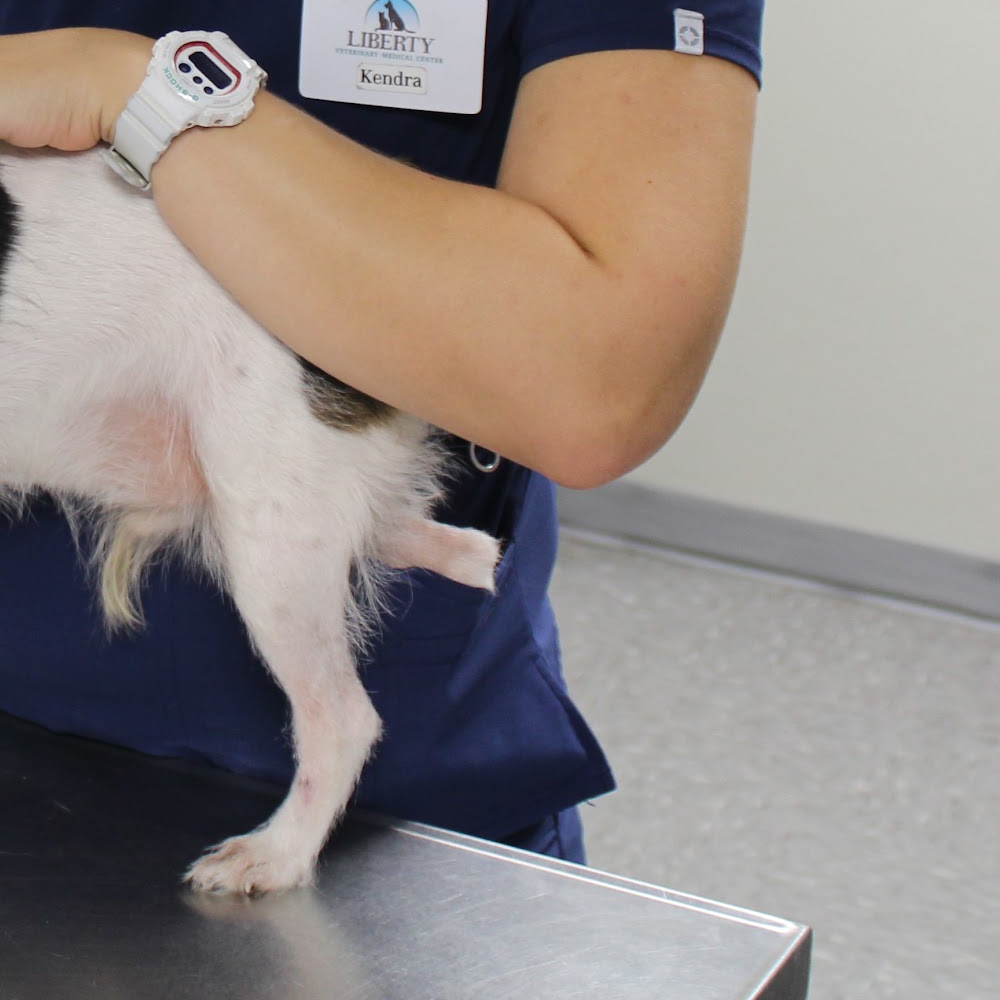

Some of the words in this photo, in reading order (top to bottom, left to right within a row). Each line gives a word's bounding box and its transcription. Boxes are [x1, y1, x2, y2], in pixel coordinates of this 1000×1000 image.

[347, 30, 436, 55] LIBERTY
[335, 47, 379, 58] VETERINARY
[382, 52, 413, 62] MEDICAL
[416, 56, 444, 64] CENTER
[162, 66, 200, 102] G-SHOCK
[359, 68, 422, 88] Kendra
